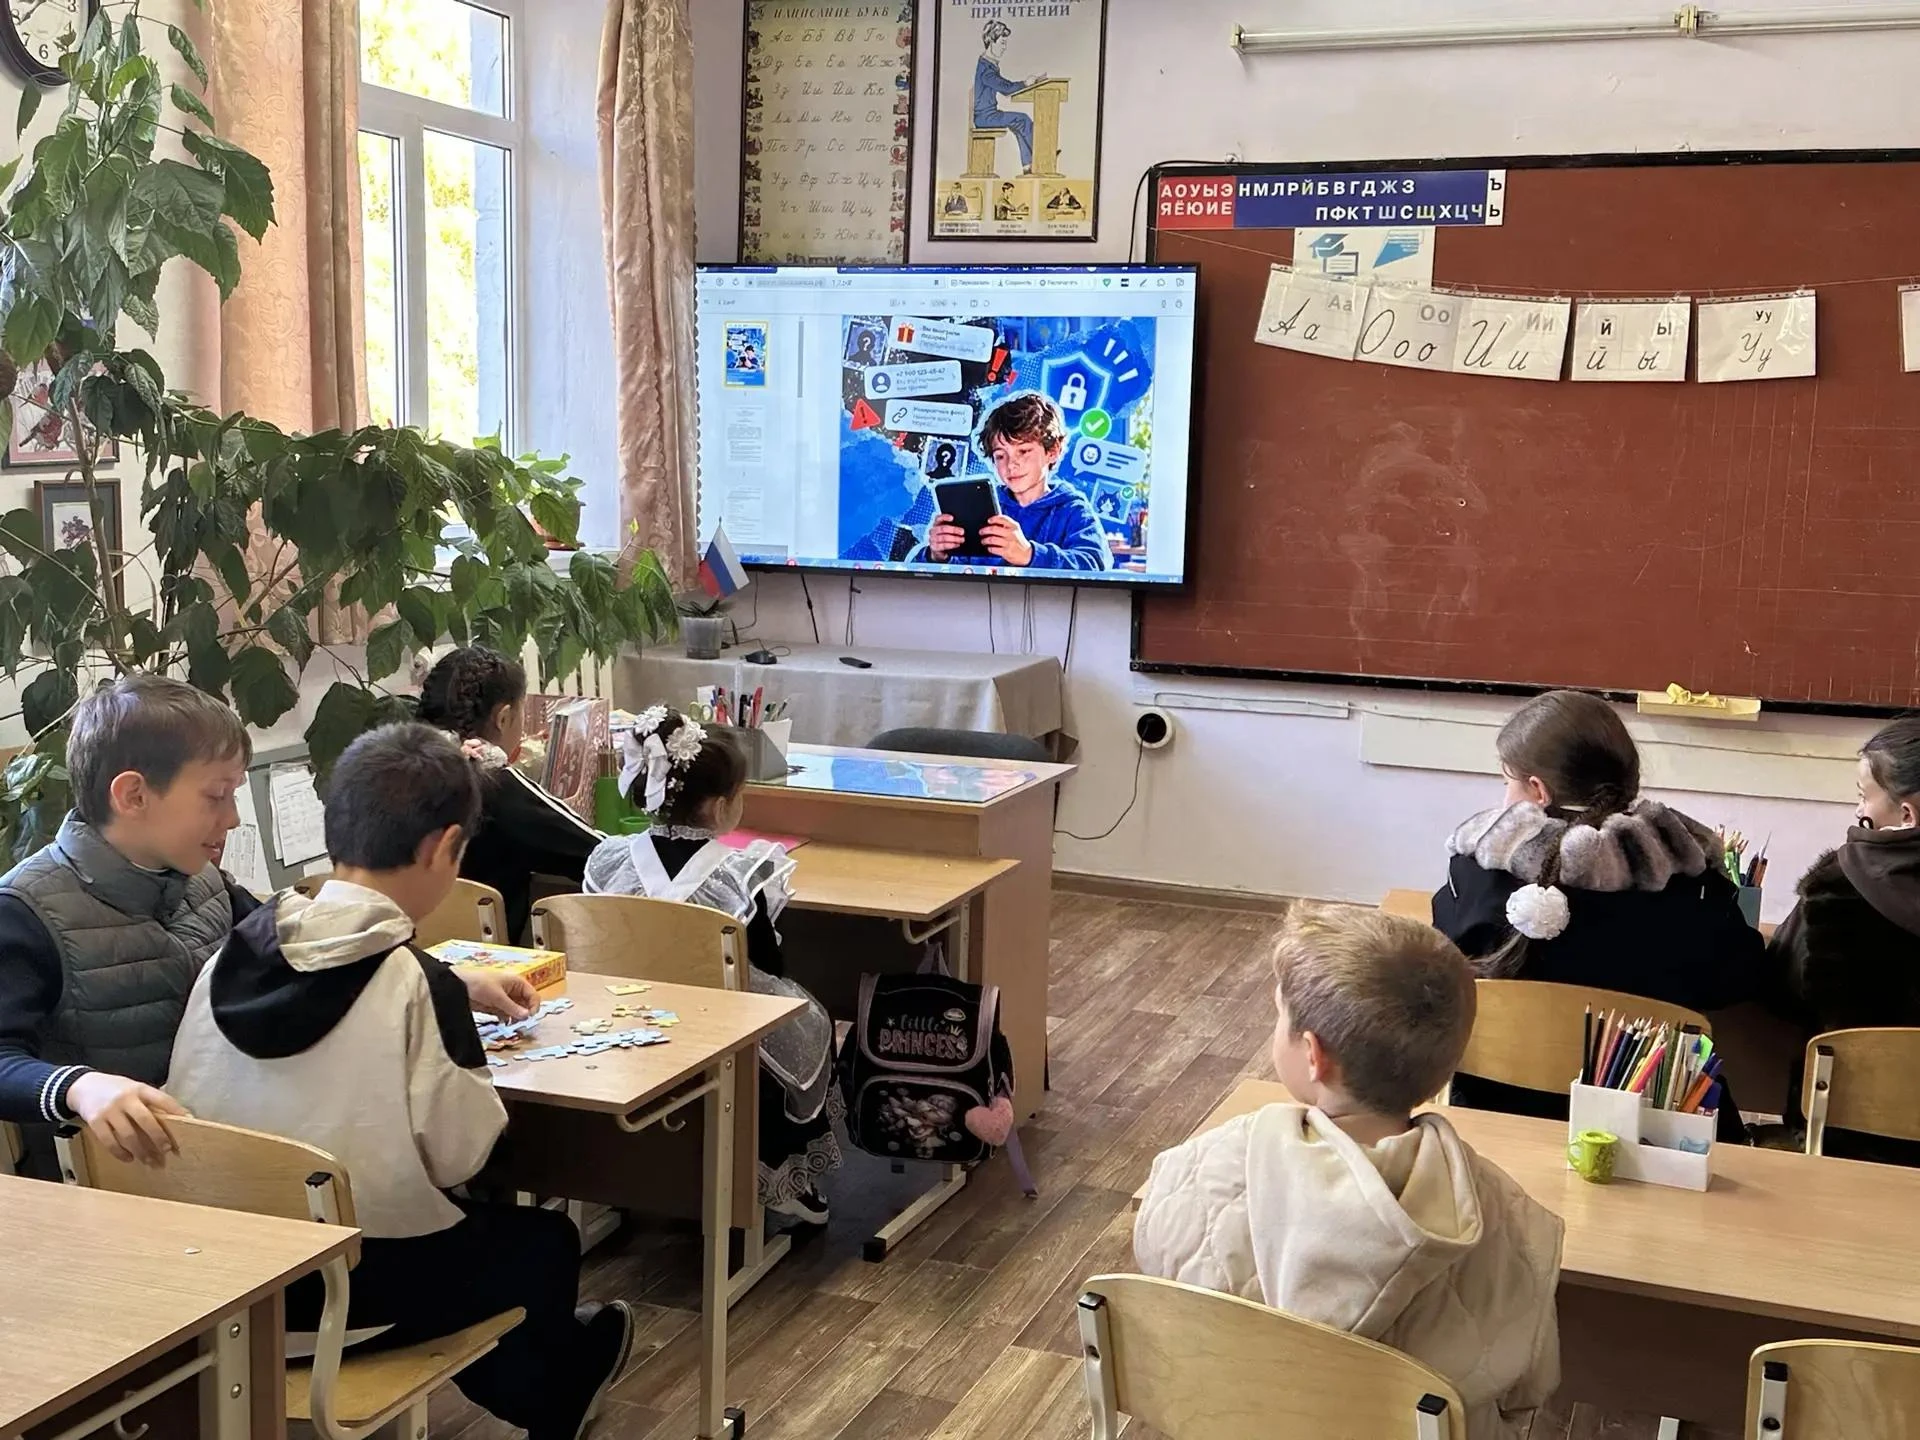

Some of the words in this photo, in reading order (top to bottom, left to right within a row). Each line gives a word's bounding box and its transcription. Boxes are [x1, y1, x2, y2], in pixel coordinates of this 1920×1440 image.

[11, 9, 21, 26] 8
[971, 7, 1000, 19] ПРИ
[1008, 5, 1070, 18] ЧТЕНИИ
[22, 32, 30, 46] 7
[39, 44, 49, 60] 6
[1160, 183, 1233, 198] АОУЫЭ
[1239, 179, 1415, 197] НМЛРЙБВГДЖЗ
[1490, 178, 1502, 191] Ъ
[1160, 200, 1232, 216] ЯЁЮИЕ
[878, 1028, 968, 1060] PRINCESS
